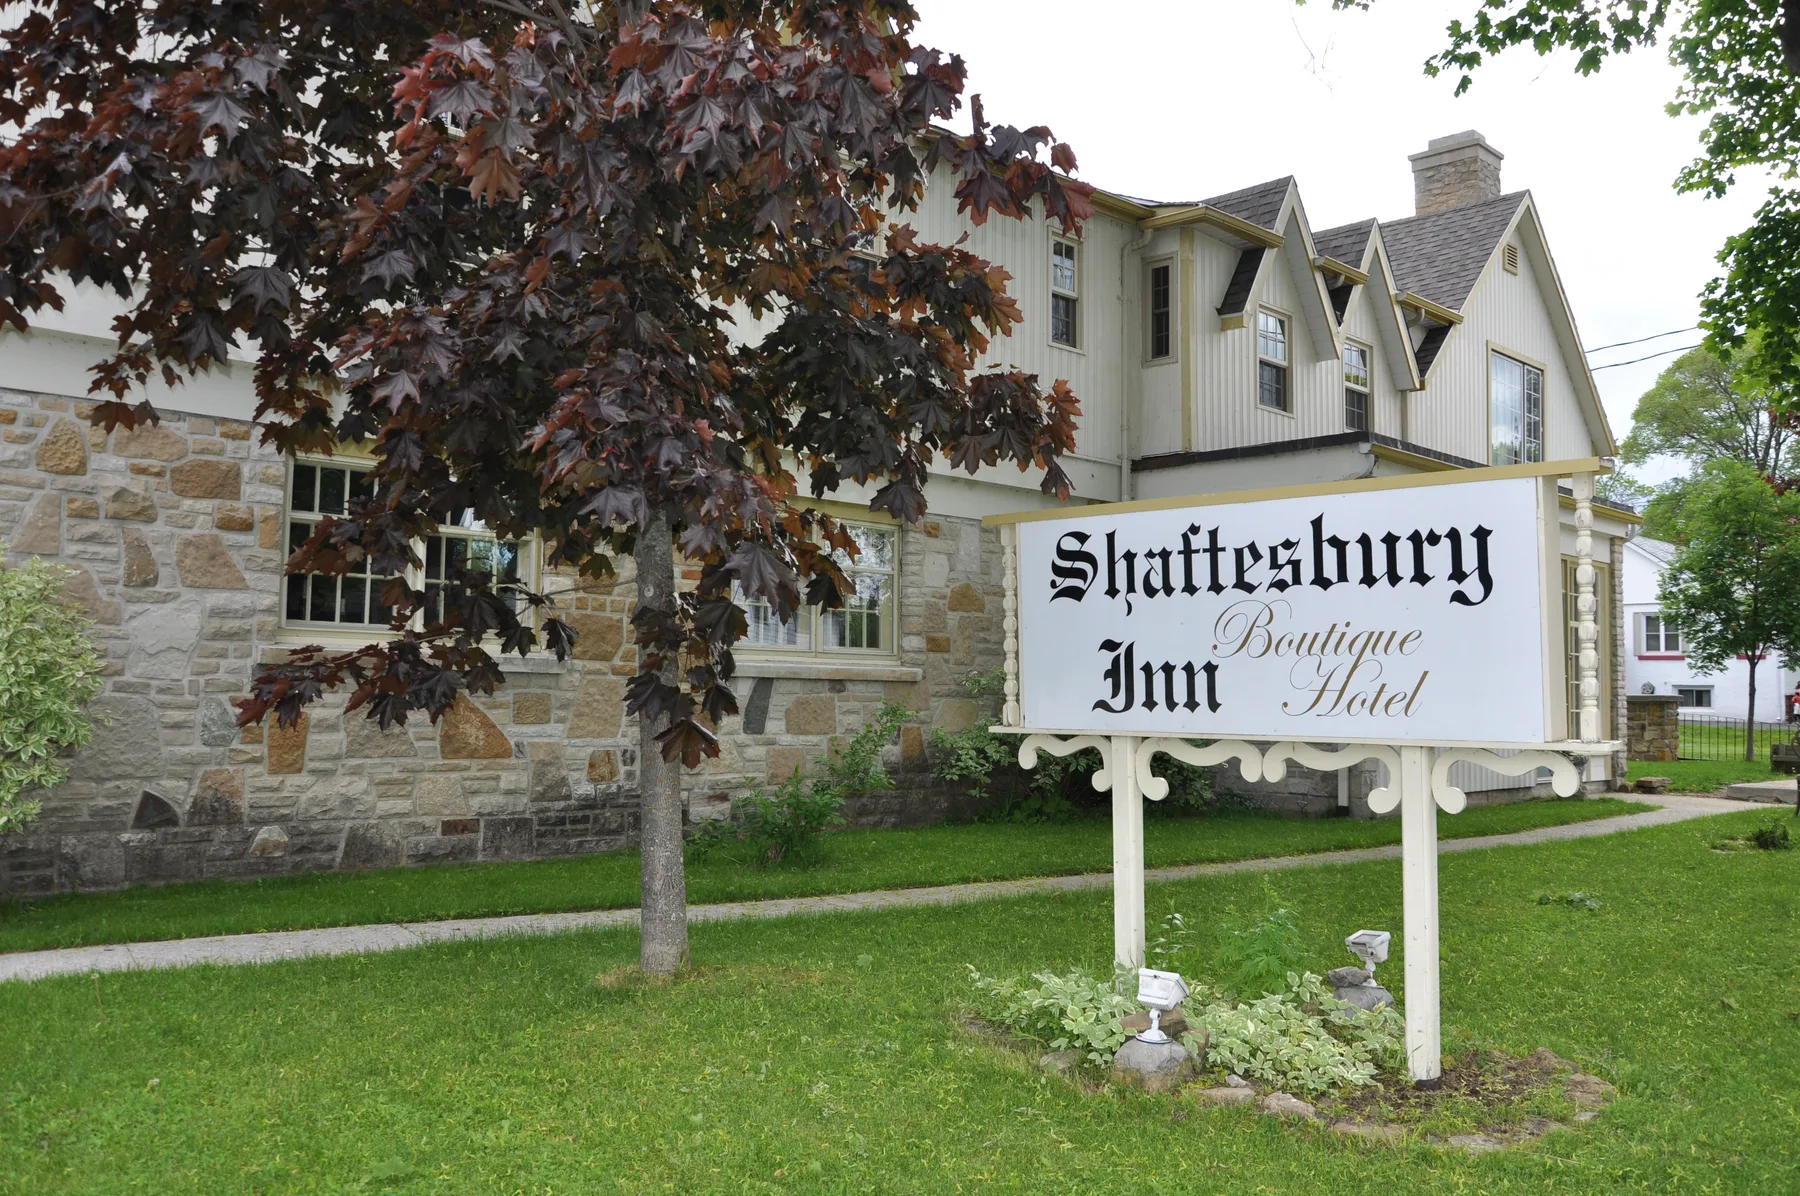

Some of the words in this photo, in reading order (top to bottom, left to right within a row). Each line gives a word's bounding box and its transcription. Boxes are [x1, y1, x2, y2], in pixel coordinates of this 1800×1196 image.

[1049, 512, 1494, 617] Shaftesbury
[1092, 638, 1222, 713] Inn
[1212, 599, 1423, 678] Boutique
[1281, 654, 1430, 717] Hotel
